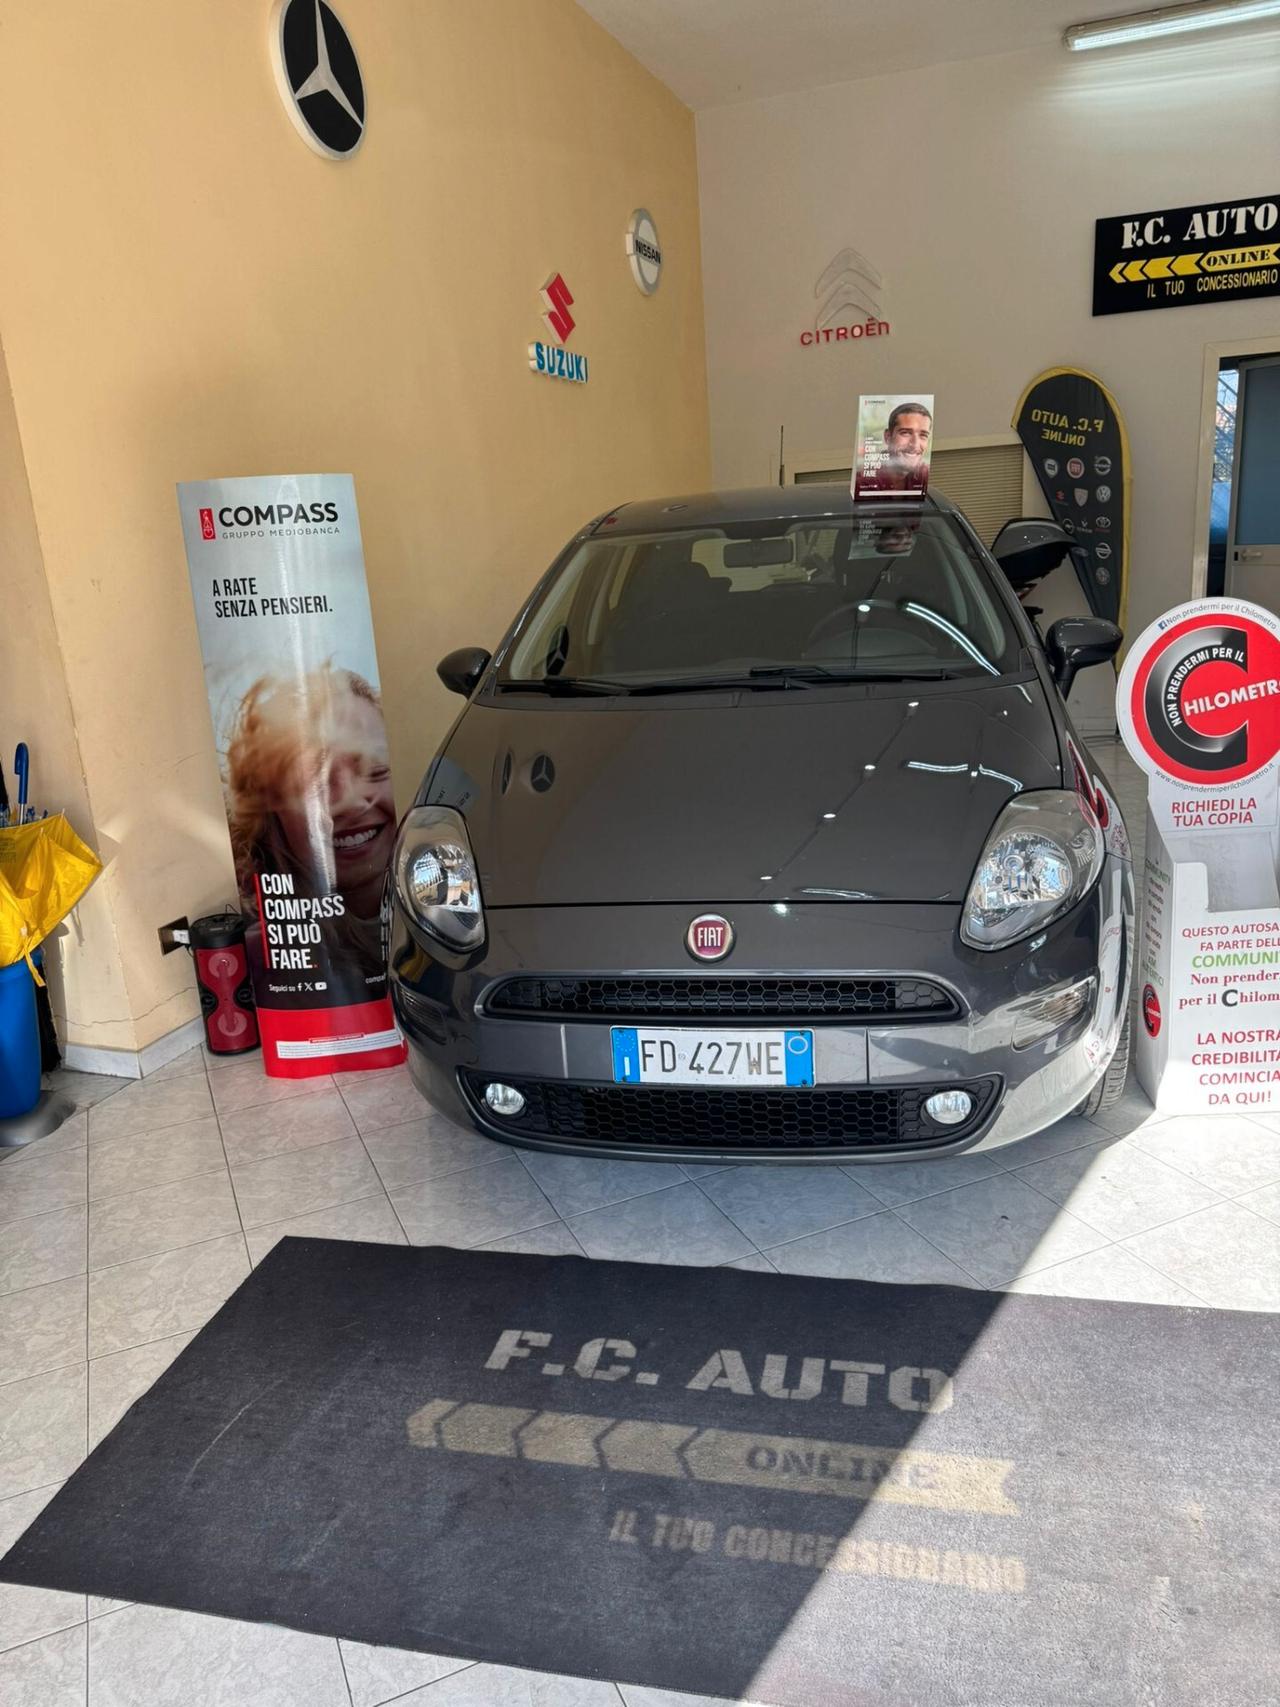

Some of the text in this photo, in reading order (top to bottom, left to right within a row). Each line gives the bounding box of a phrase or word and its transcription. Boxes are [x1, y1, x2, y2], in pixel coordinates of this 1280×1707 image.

[1121, 203, 1279, 249] F.C. AUTO
[635, 239, 661, 264] NISSAN
[1206, 249, 1270, 267] ONLINE
[1147, 269, 1279, 298] IL TUO CONCESSIONARIO
[534, 341, 588, 384] SUZUKI
[219, 502, 339, 528] COMPASS
[222, 527, 340, 540] GRUPPO MEDIOBANCA
[212, 577, 258, 597] A RATE
[215, 595, 333, 618] SENZA PENSIERI.
[1166, 603, 1277, 630] Non prendermi per il Chilometro
[1166, 647, 1244, 727] NON PRENDERMI PER IL
[1184, 679, 1280, 717] HILOMETR
[1171, 797, 1257, 814] RICHIEDI LA
[1174, 811, 1254, 827] TUA COPIA
[260, 873, 294, 895] CON
[264, 895, 345, 920] COMPASS
[267, 919, 322, 945] SI PUÒ
[697, 927, 724, 947] FIAT
[1182, 925, 1229, 938] QUESTO
[1200, 941, 1214, 951] FA
[1217, 939, 1253, 951] PARTE
[1192, 950, 1280, 968] COMMUNI
[269, 983, 288, 993] Seguici
[1190, 969, 1280, 986] Non prender
[1179, 997, 1203, 1009] per
[1207, 993, 1217, 1005] il
[1197, 1032, 1217, 1045] LA
[640, 1040, 677, 1073] FD
[1208, 1090, 1271, 1105] DA QUI!
[484, 1329, 954, 1414] F.C. AUTO
[744, 1444, 938, 1491] ONLINE
[609, 1509, 1028, 1594] IL TUO CONCESSIONARIO
